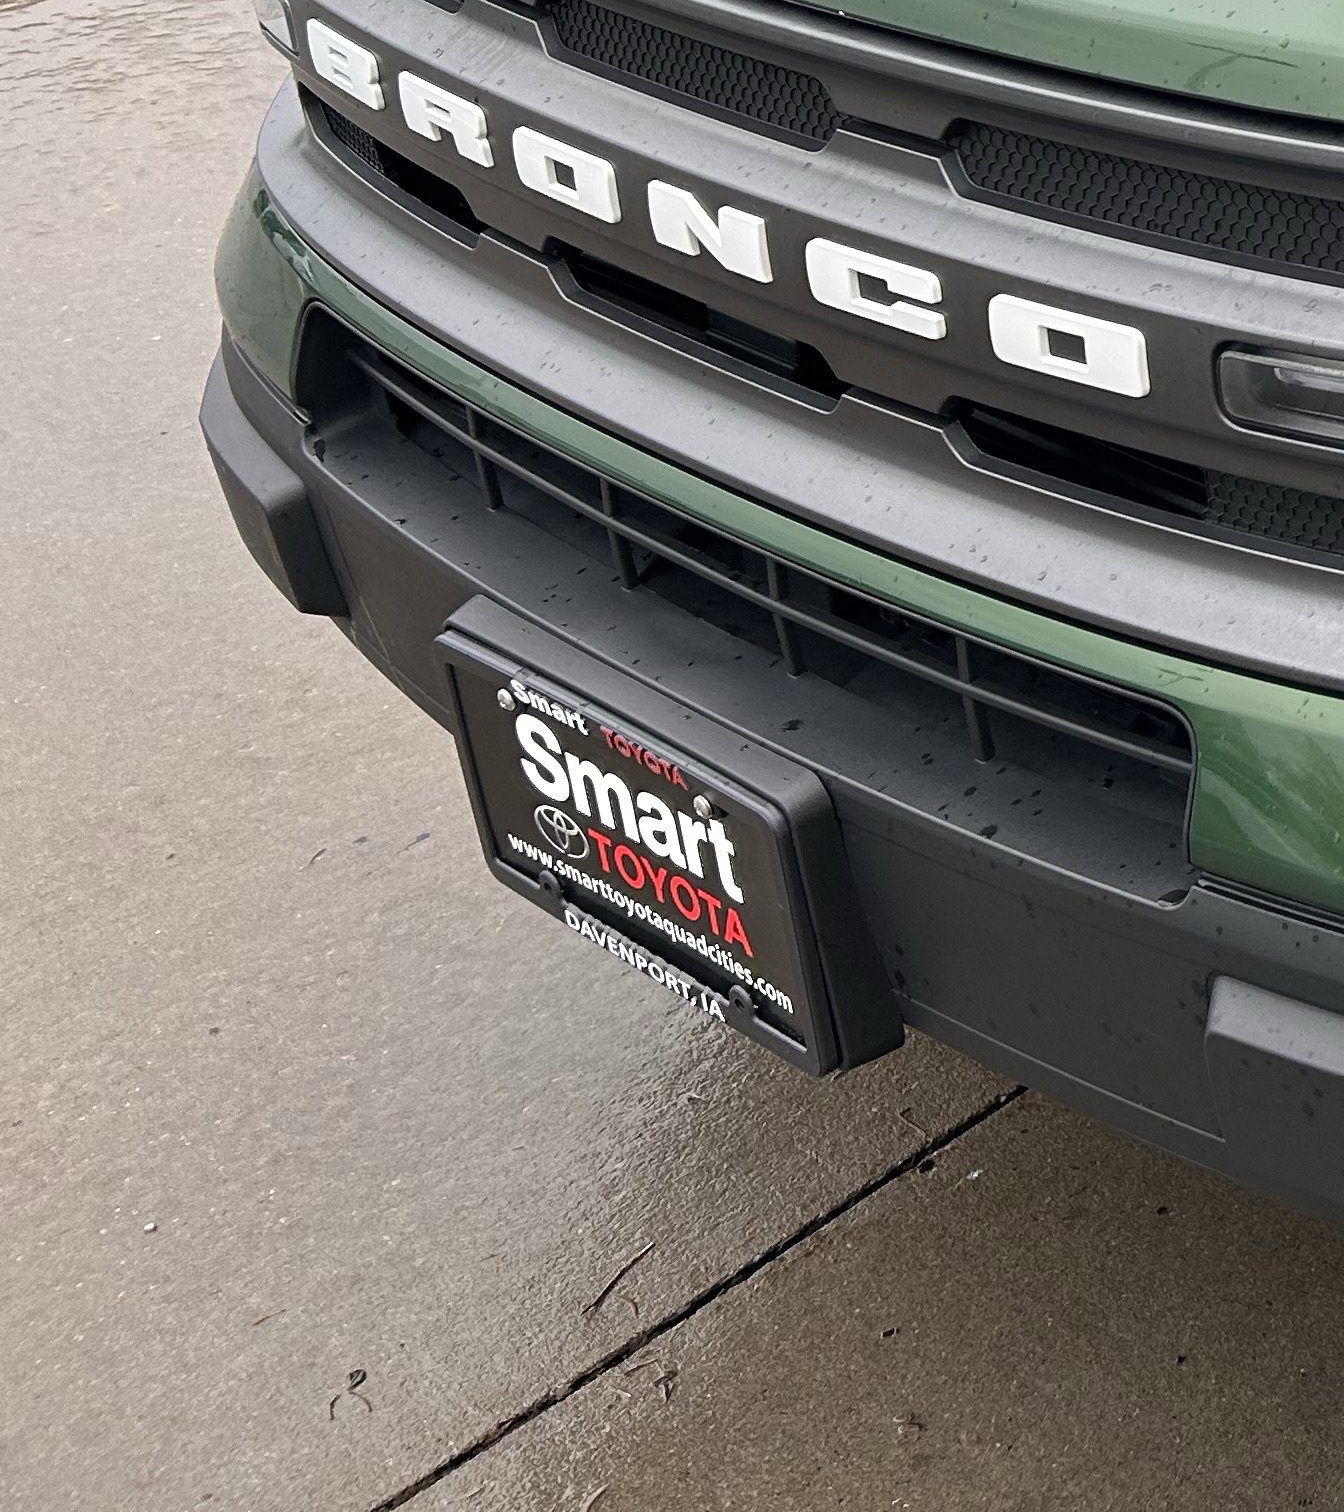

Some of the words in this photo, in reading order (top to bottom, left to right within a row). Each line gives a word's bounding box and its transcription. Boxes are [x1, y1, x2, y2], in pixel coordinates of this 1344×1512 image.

[306, 17, 1151, 398] BRONCO
[510, 679, 590, 736] Smart
[600, 725, 689, 791] TOYOTA
[515, 713, 745, 904] Smart
[507, 833, 795, 1015] www.smarttoyotaquadcities.com
[564, 910, 697, 1007] DAVENPORT,
[701, 993, 726, 1023] IA
[587, 827, 754, 958] TOYOTA
